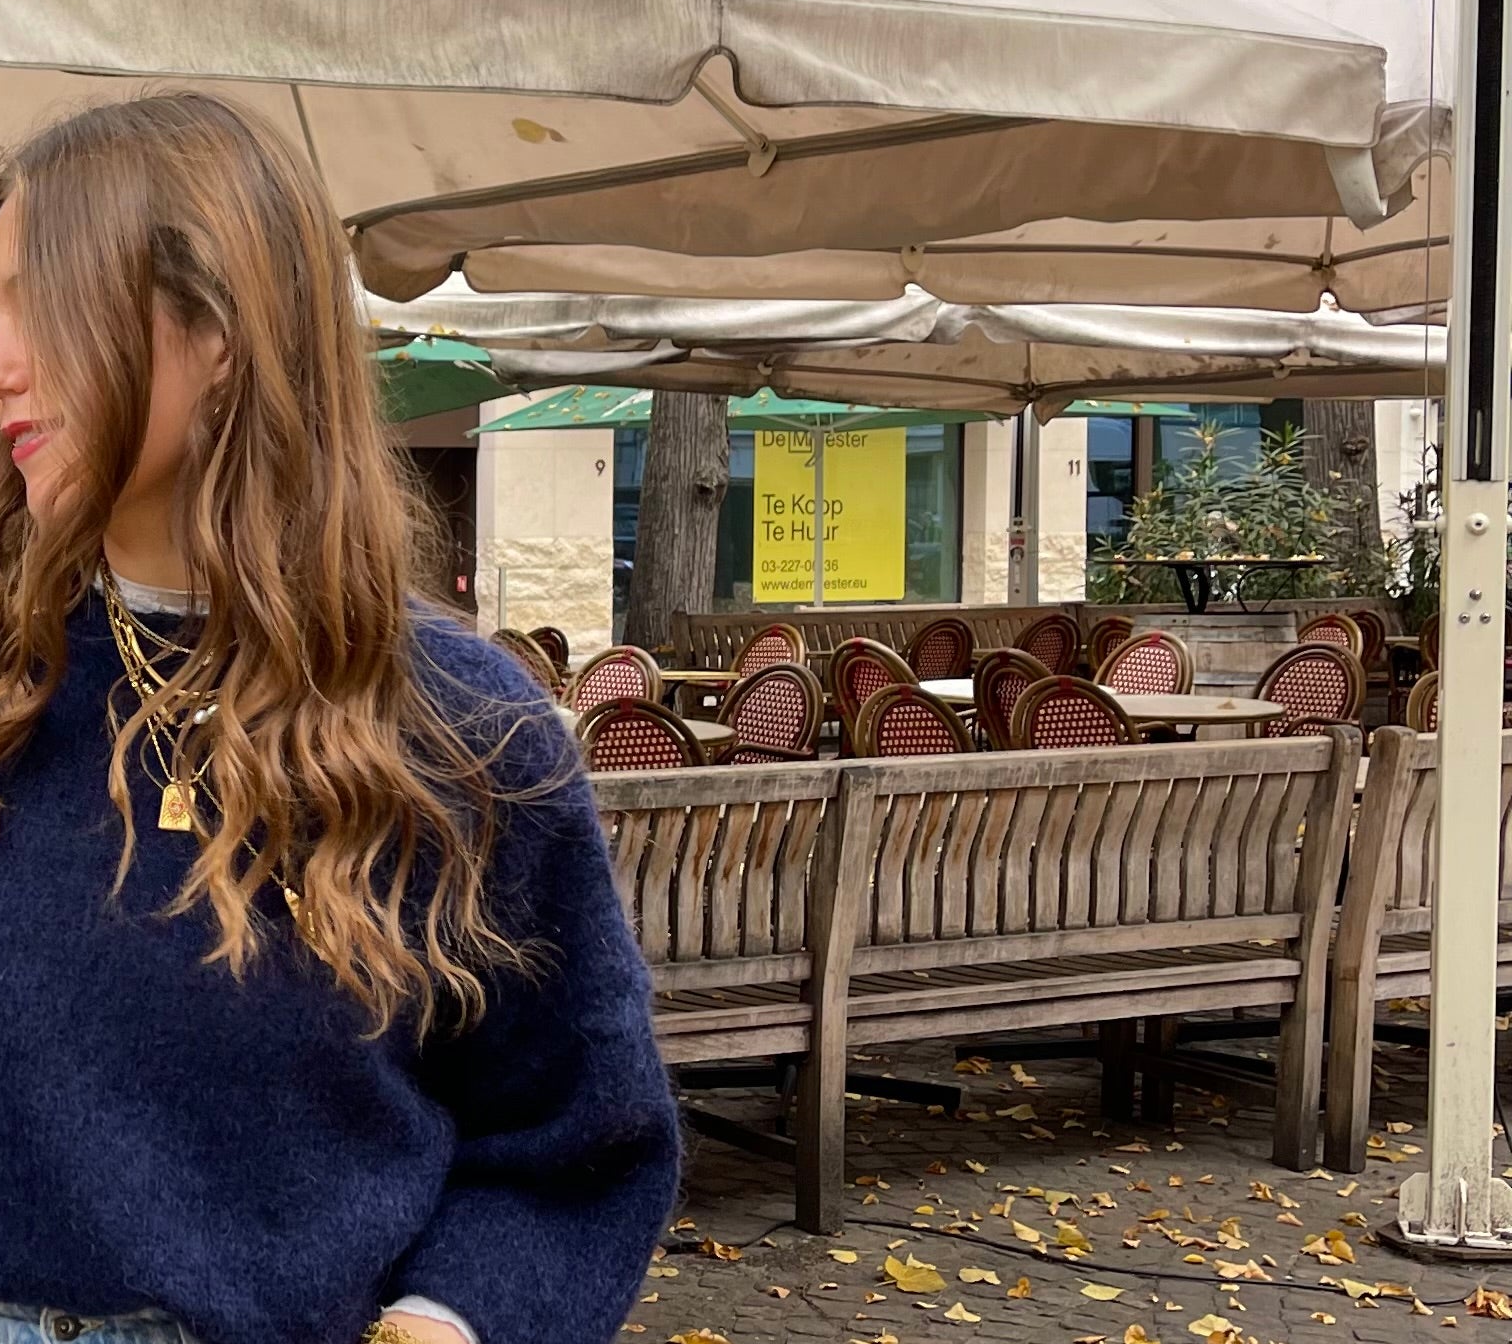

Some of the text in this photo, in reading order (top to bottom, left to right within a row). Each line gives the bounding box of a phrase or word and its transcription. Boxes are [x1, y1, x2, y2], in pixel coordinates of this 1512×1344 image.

[762, 430, 868, 448] De Mester
[594, 459, 606, 476] 9
[1068, 459, 1081, 476] 11
[761, 493, 844, 520] Te Koop
[761, 520, 840, 542] Te Huur
[761, 577, 867, 591] www.demester.eu
